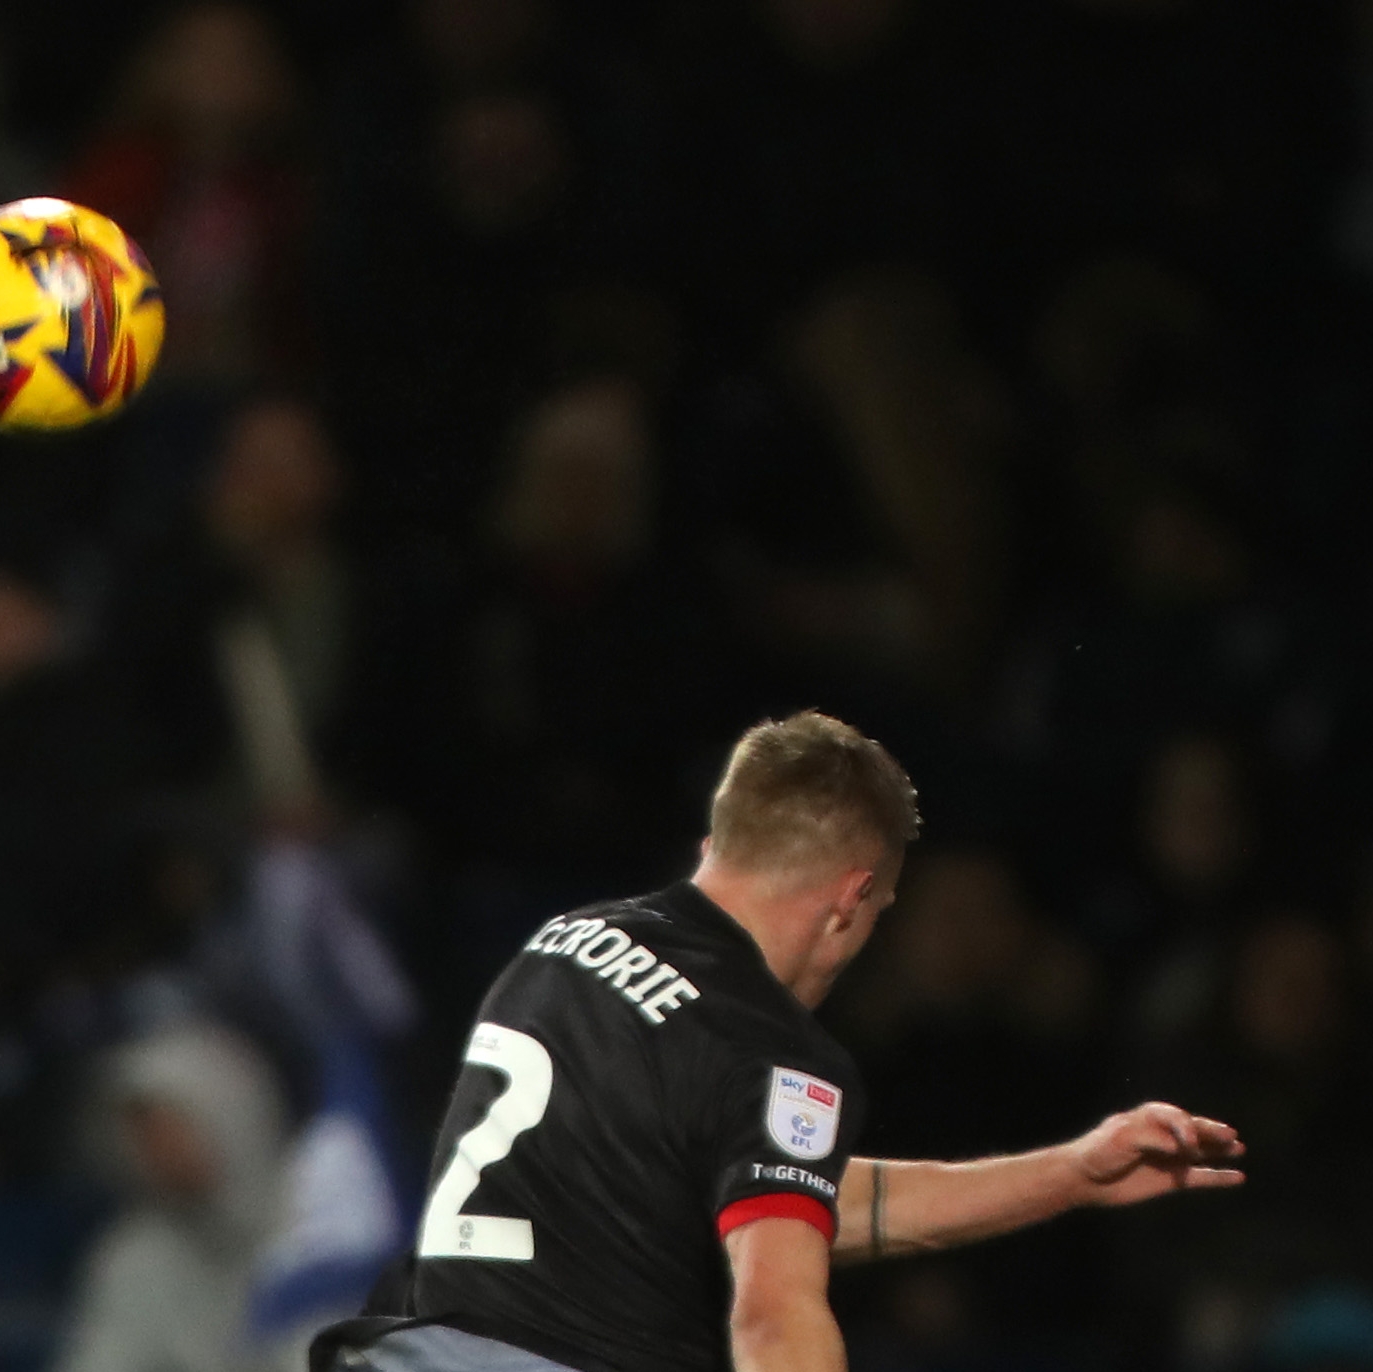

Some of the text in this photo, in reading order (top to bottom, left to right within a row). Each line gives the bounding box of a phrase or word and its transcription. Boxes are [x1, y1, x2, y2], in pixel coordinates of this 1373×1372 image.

[781, 1076, 805, 1093] sky
[419, 1022, 553, 1261] 2
[791, 1135, 812, 1151] EFL
